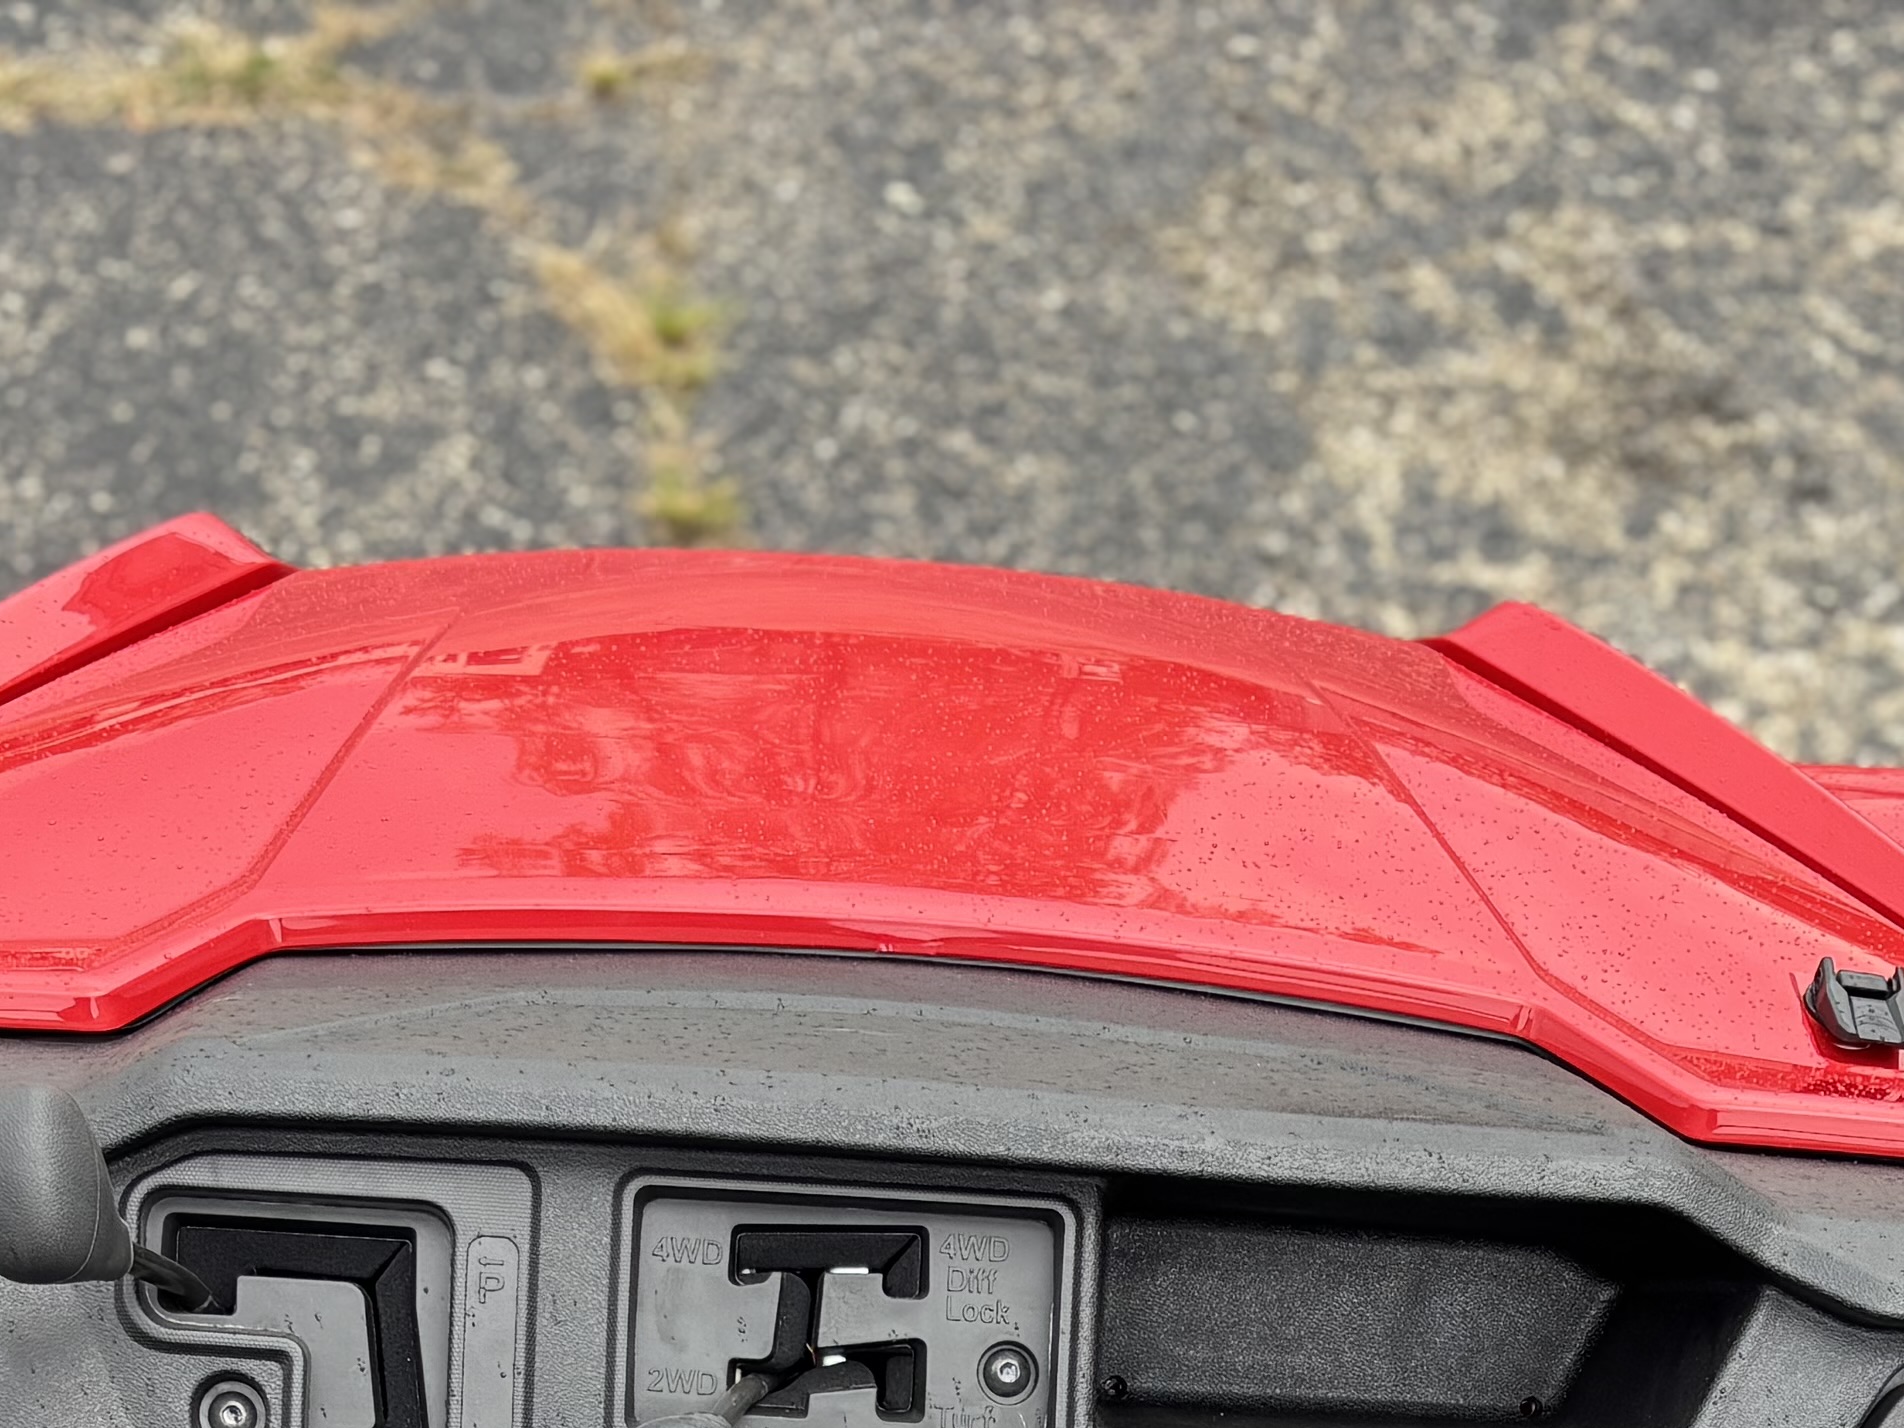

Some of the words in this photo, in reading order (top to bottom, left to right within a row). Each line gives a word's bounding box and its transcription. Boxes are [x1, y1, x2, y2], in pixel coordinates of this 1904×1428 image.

[652, 1236, 723, 1265] 4WD
[939, 1232, 1010, 1262] 4WD
[478, 1271, 505, 1304] P
[946, 1265, 997, 1294] Diff
[946, 1295, 1010, 1324] Lock
[647, 1367, 718, 1395] 2WD
